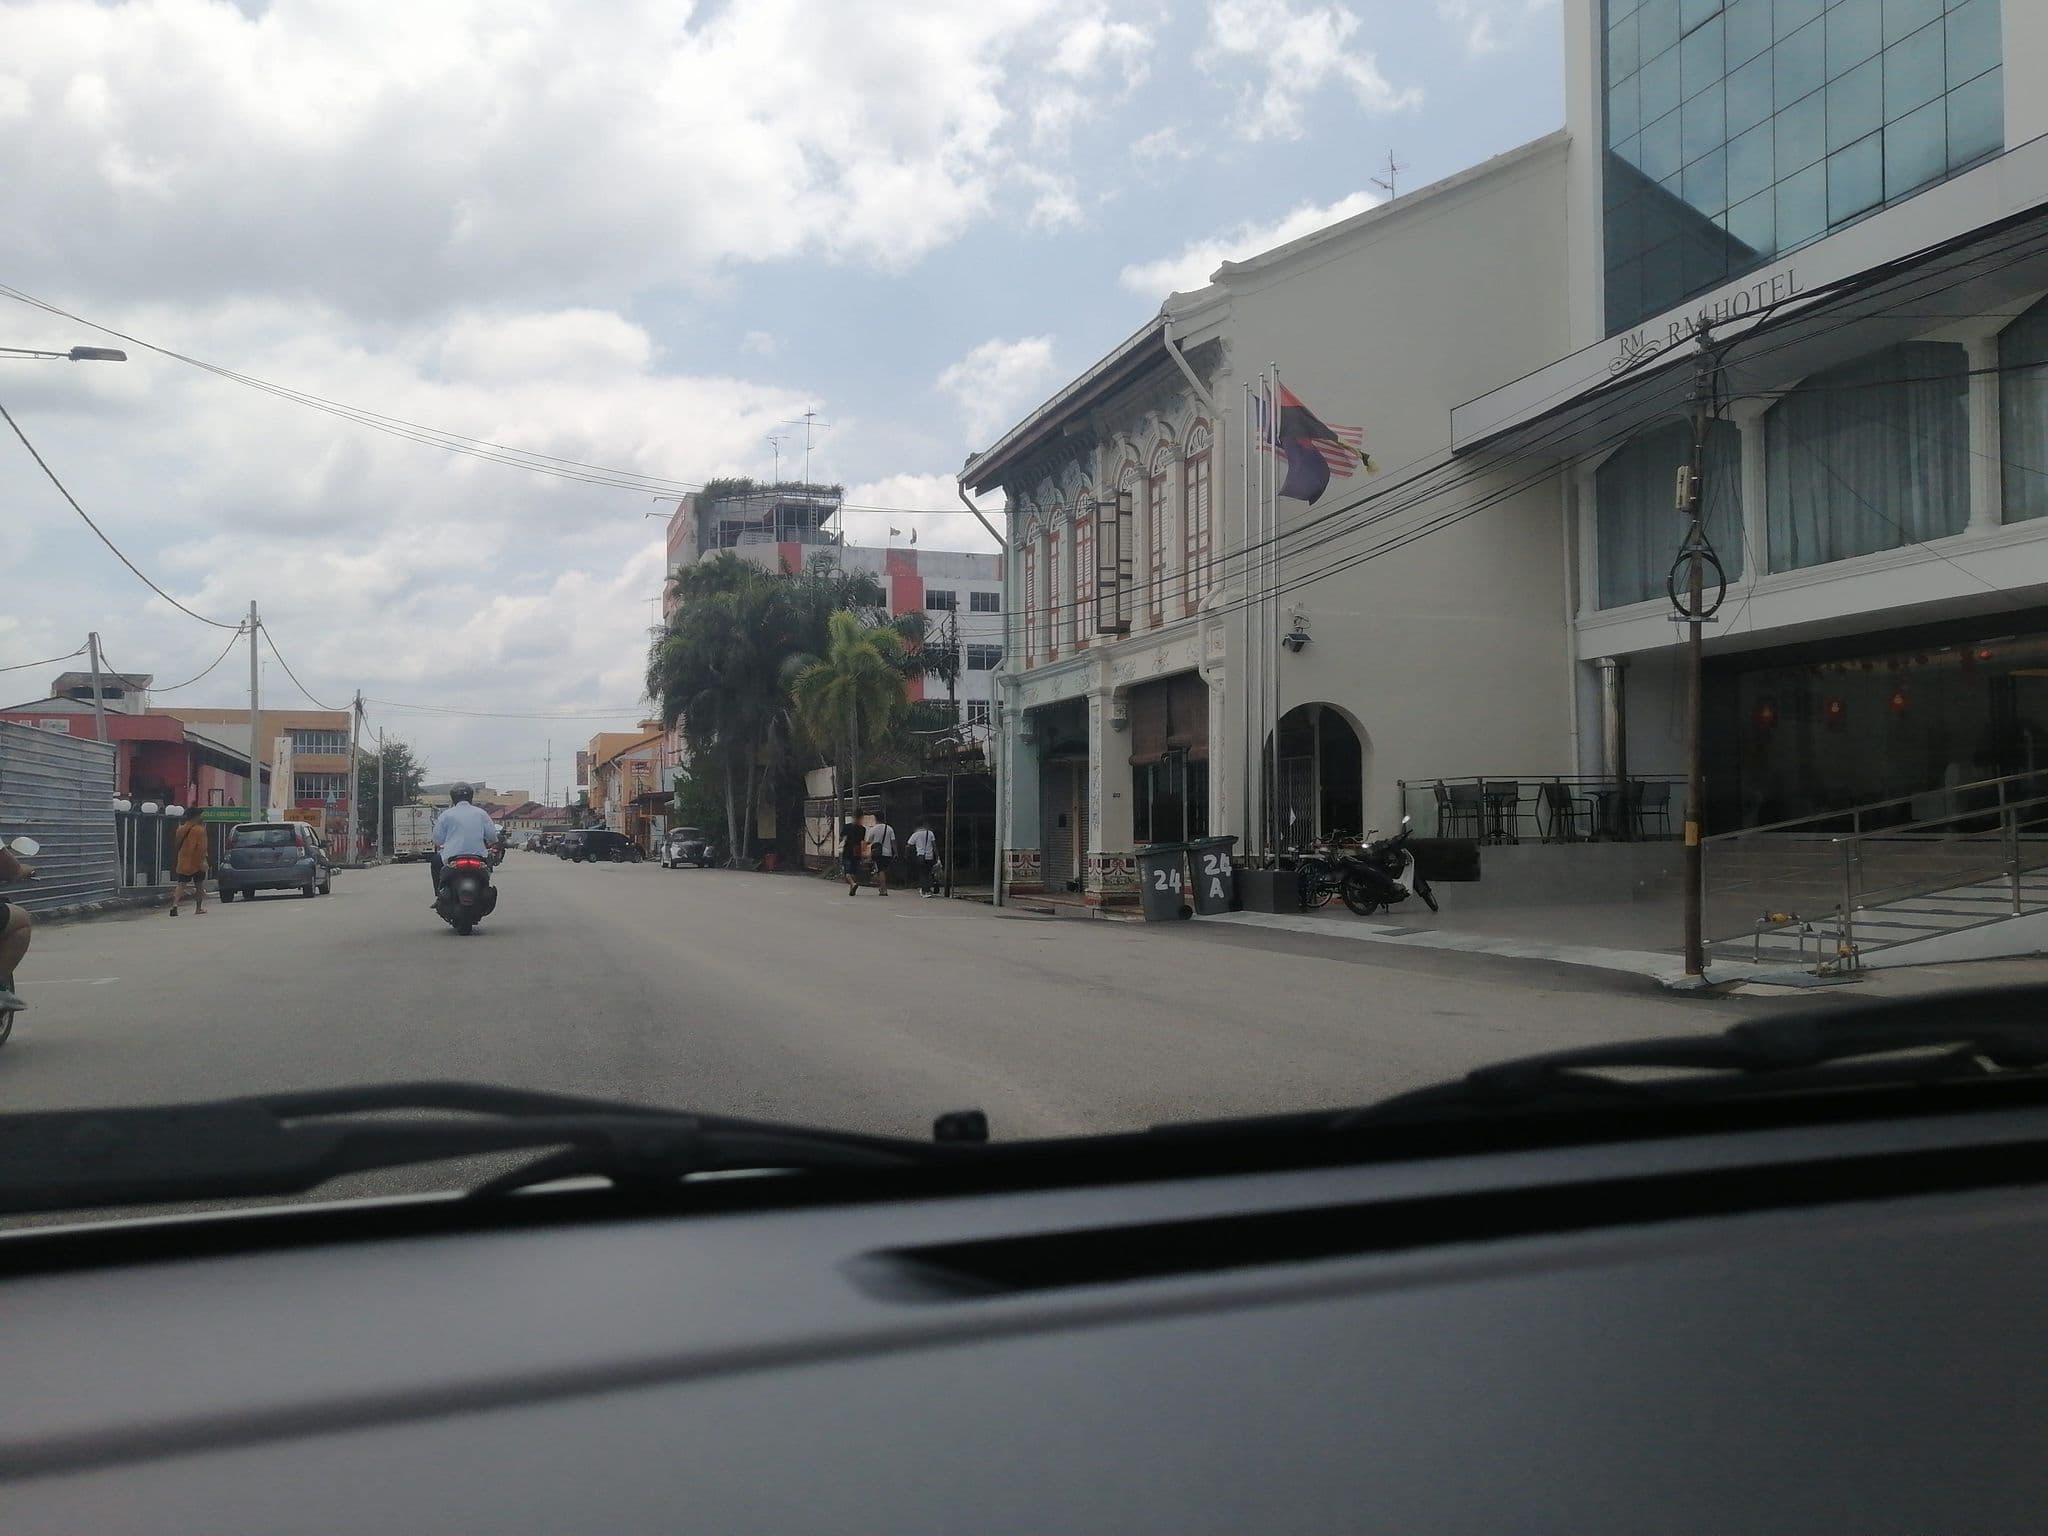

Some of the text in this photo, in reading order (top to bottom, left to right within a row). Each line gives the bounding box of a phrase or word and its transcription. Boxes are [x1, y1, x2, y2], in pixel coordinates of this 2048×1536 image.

[1668, 269, 1804, 344] RM HOTEL
[1619, 329, 1645, 356] RM
[1203, 853, 1232, 876] 24
[1153, 868, 1182, 894] 24
[1209, 877, 1225, 898] A
